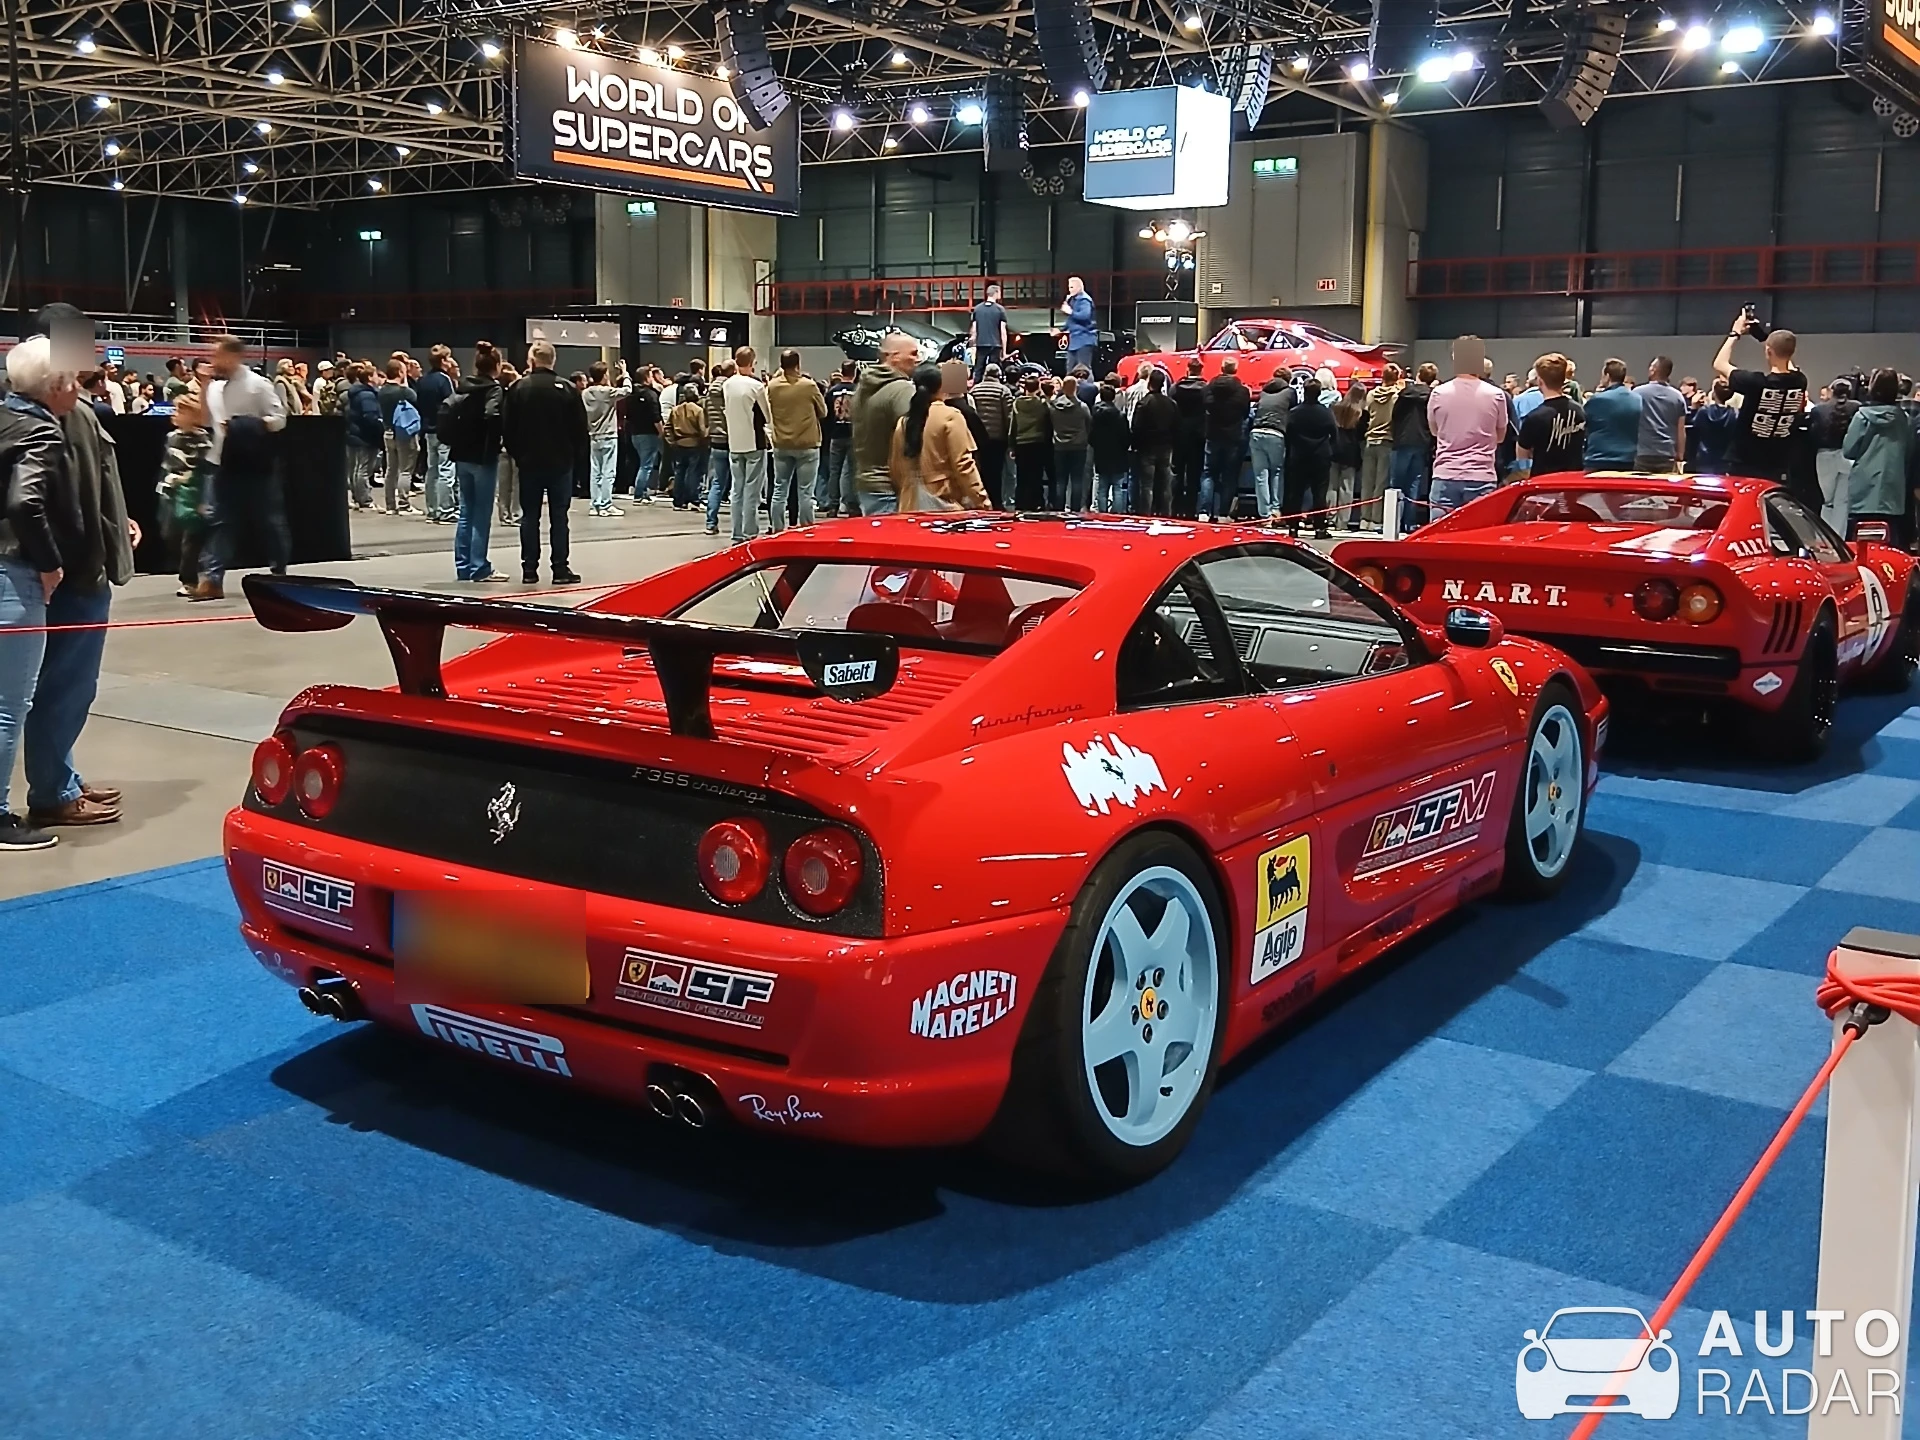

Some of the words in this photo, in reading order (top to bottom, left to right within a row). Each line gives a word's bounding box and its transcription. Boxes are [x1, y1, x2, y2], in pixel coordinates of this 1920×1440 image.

[566, 65, 704, 126] WORLD
[552, 110, 774, 192] SUPERCARS
[1146, 124, 1168, 140] OF
[1442, 579, 1568, 606] N.A.R.T.
[828, 662, 871, 684] Sabelt
[303, 875, 354, 913] SF
[1260, 922, 1298, 967] Agip
[685, 966, 774, 1010] SF
[910, 970, 1017, 1023] MAGNETI
[910, 996, 1013, 1039] MARELLI
[410, 1004, 573, 1077] PIRELLI
